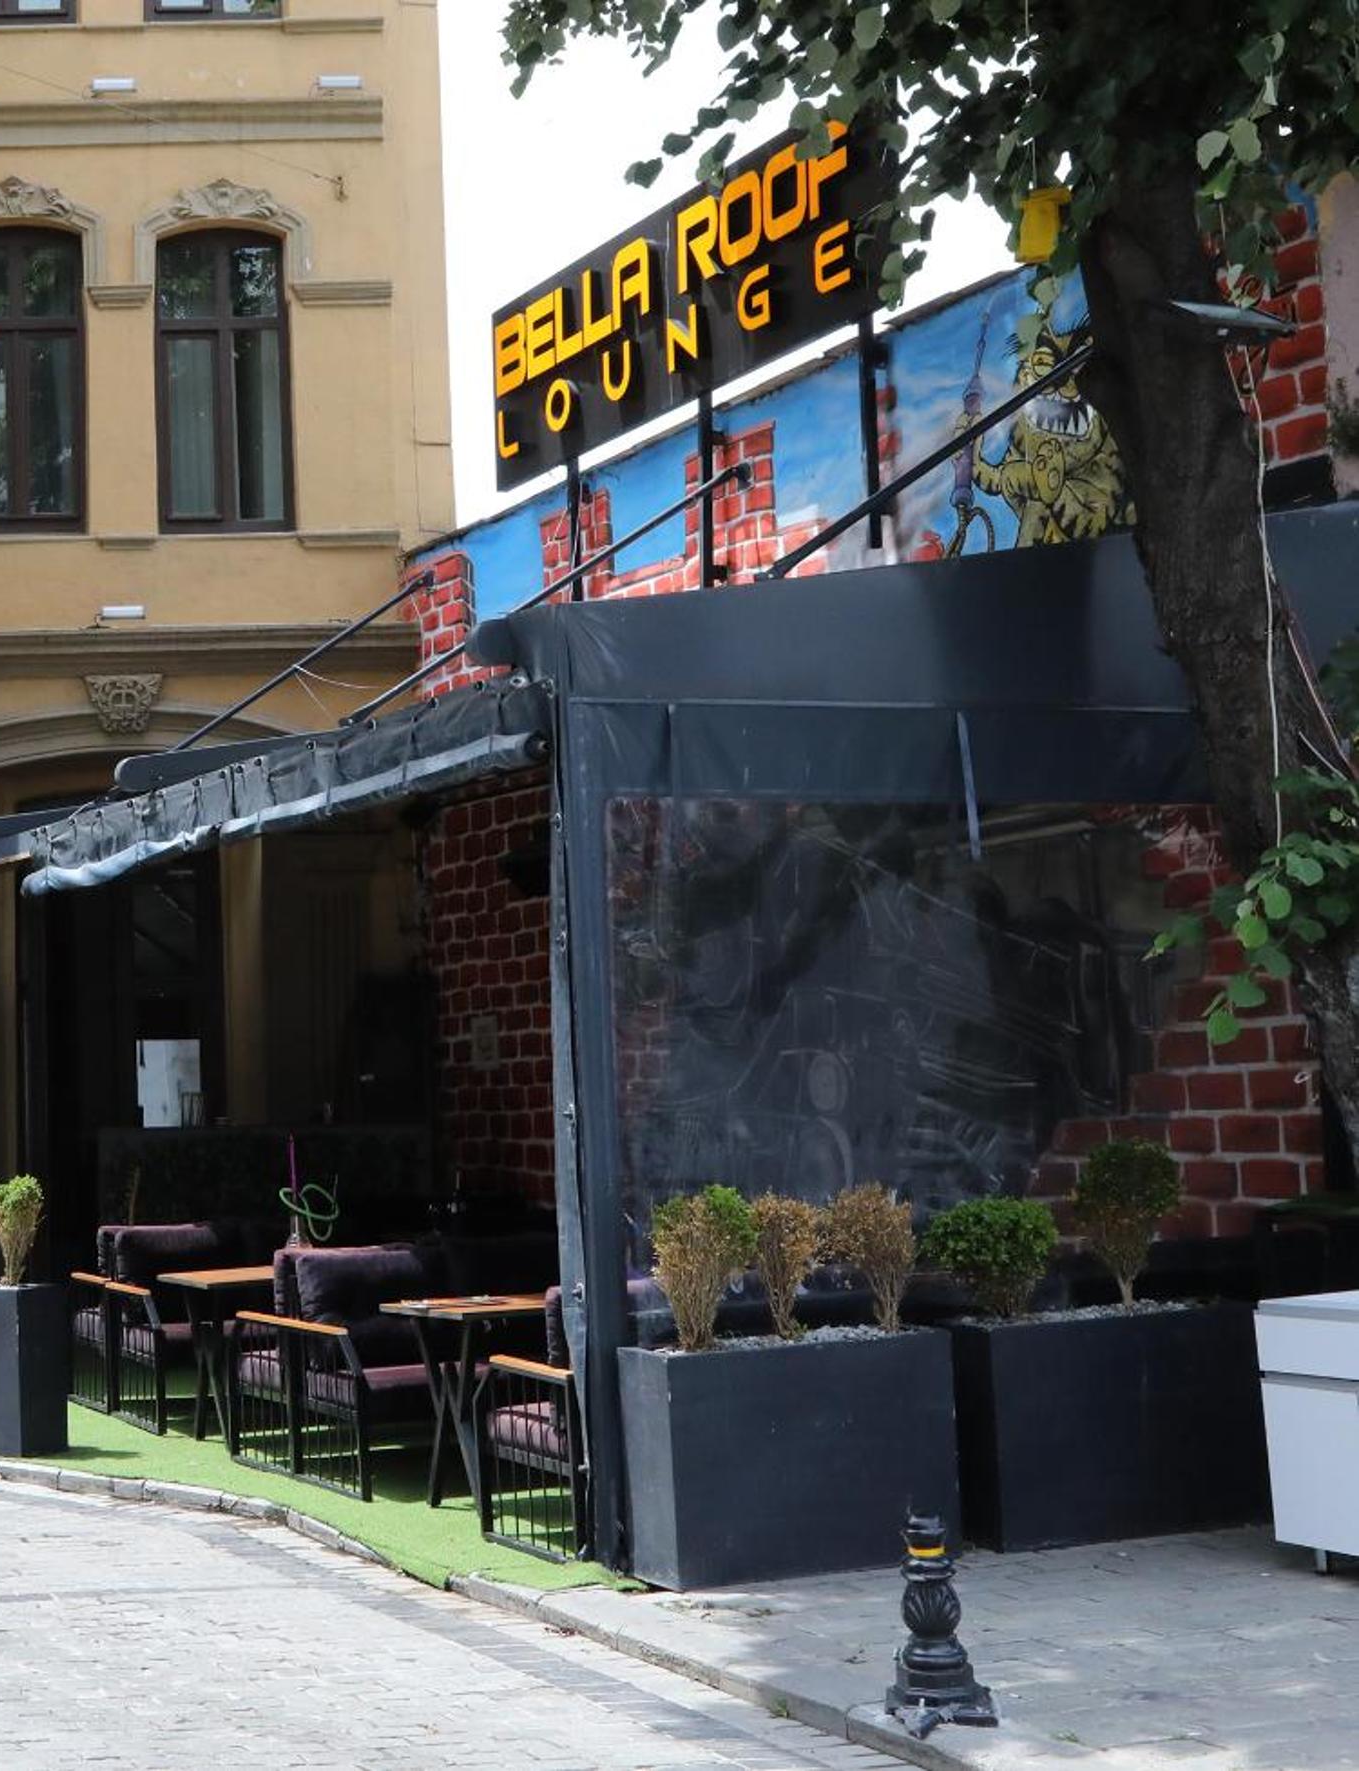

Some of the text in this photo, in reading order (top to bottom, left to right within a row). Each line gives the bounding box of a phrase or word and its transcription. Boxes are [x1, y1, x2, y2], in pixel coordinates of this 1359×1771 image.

[494, 119, 848, 399] BELLA ROOF
[497, 220, 852, 460] LOUNGE
